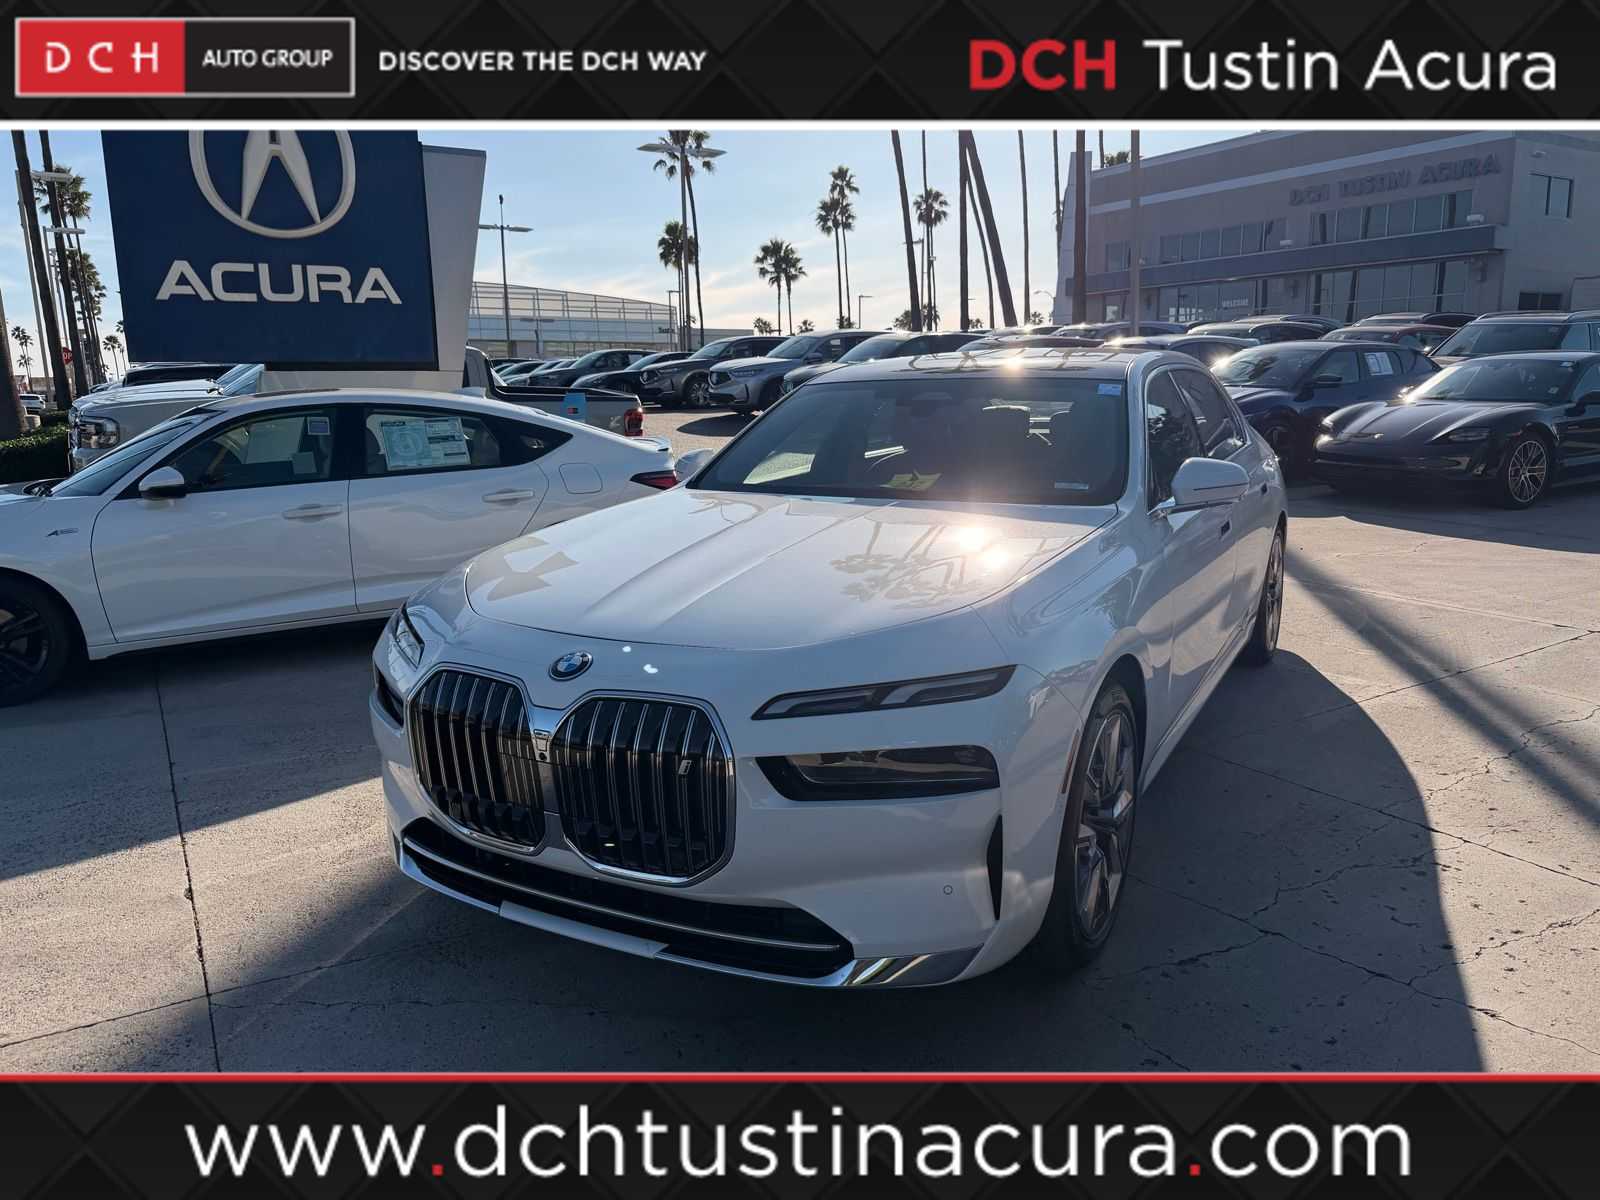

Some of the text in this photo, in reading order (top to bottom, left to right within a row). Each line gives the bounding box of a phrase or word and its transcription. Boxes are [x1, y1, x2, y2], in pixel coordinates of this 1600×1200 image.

[1338, 169, 1410, 197] TUSTIN
[1418, 153, 1502, 186] ACURA
[156, 260, 402, 305] ACURA
